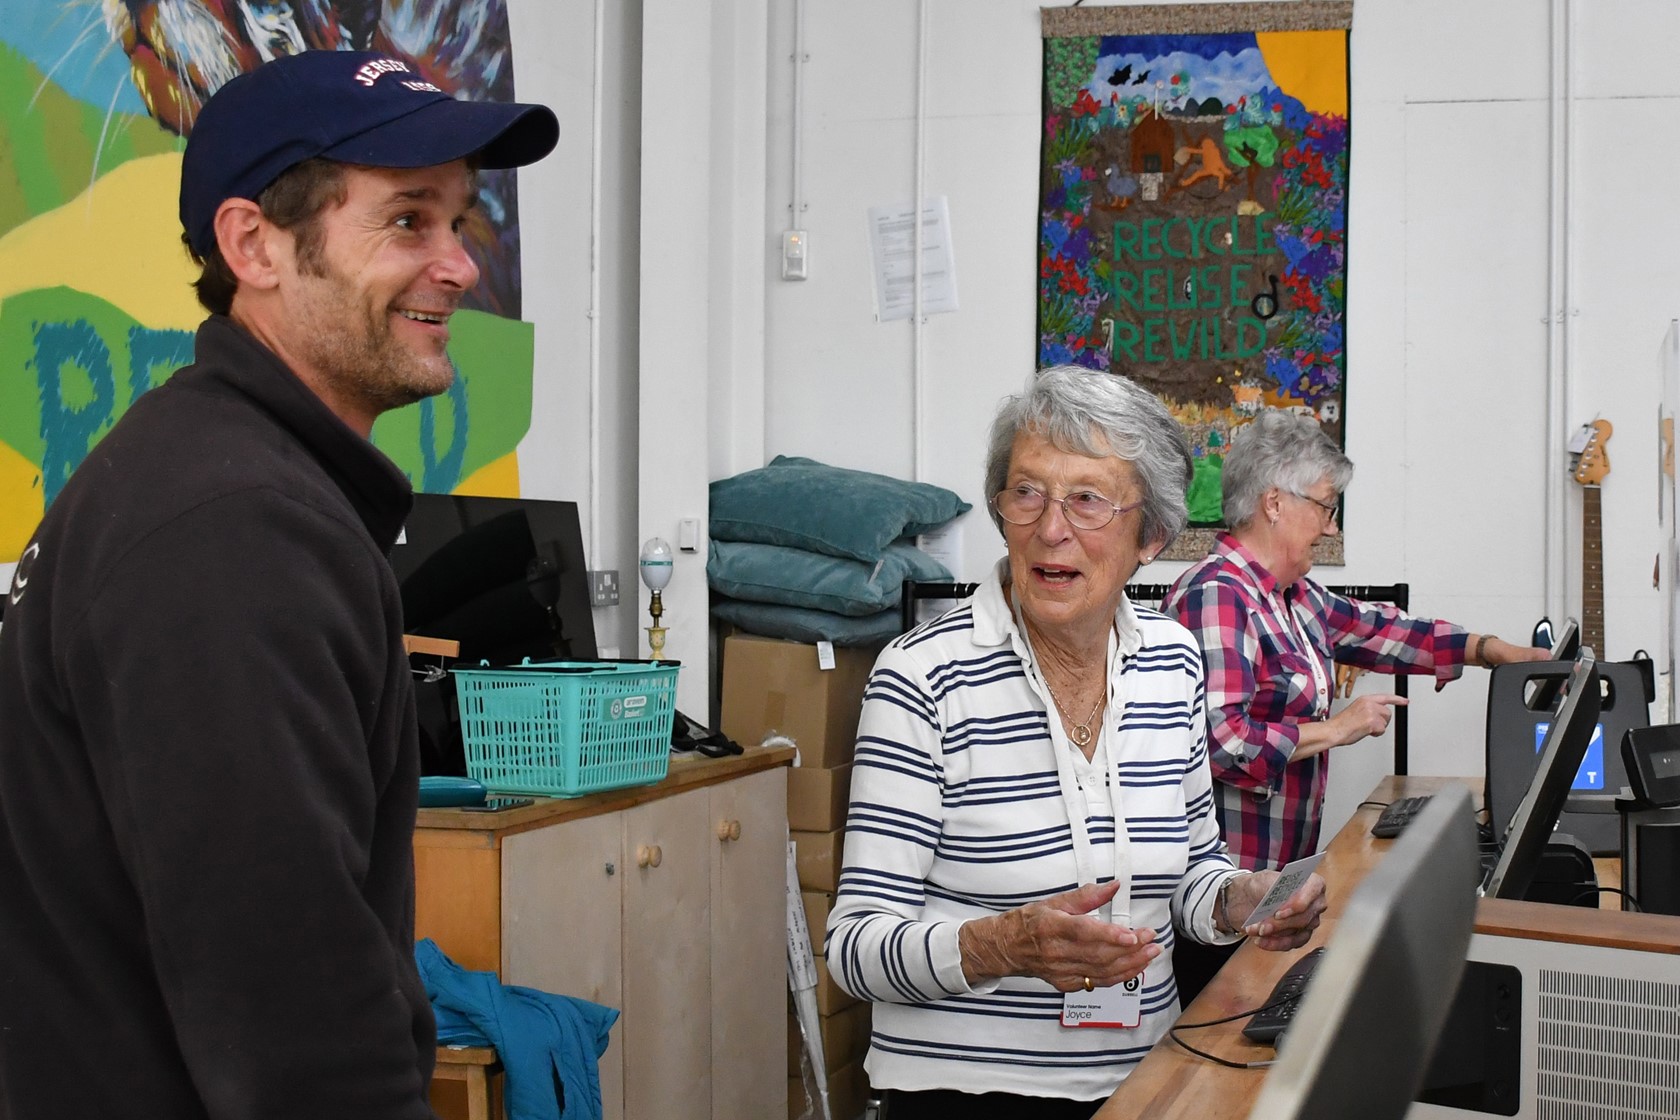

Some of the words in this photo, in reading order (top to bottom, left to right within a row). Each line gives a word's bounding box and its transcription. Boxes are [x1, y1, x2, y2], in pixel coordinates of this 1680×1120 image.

[354, 59, 410, 87] JERSEY
[1114, 212, 1278, 261] RECYCLE
[1114, 264, 1253, 312] REUSE
[1114, 315, 1268, 363] REWILD
[1066, 1010, 1092, 1020] Joyce
